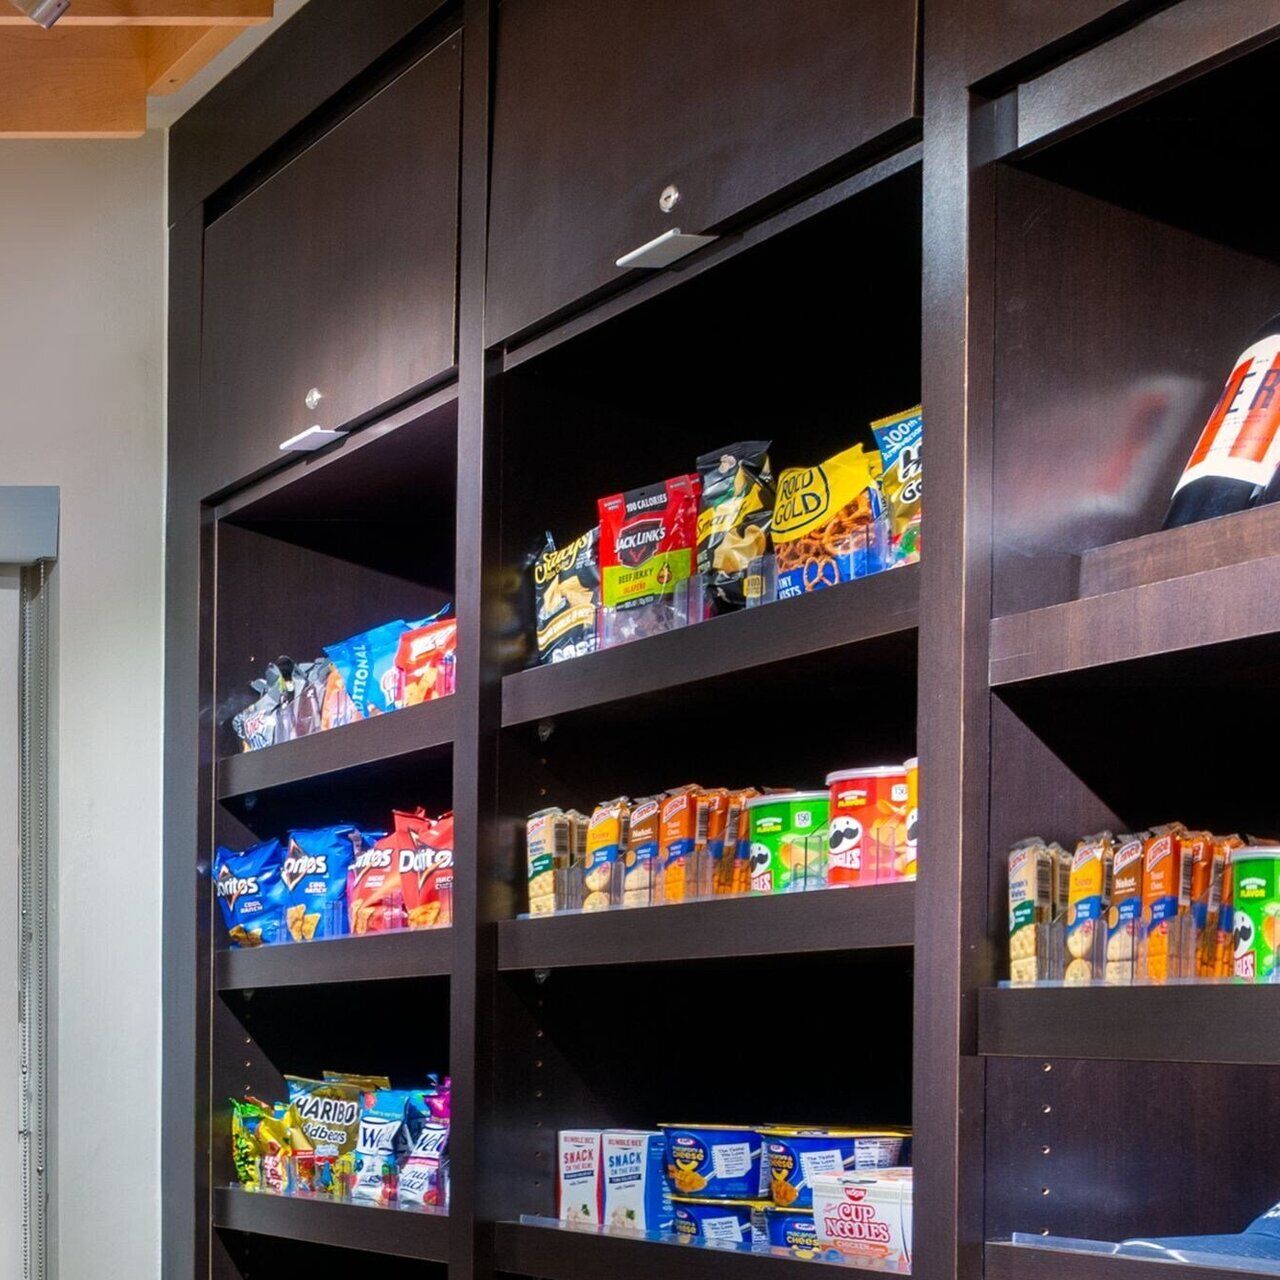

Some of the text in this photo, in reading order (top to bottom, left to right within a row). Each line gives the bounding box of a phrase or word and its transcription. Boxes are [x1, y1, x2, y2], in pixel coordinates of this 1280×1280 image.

[781, 469, 814, 500] ROLD
[638, 493, 667, 510] CALORIES
[775, 492, 822, 525] GOLD
[614, 527, 666, 553] JACK LINK'S
[618, 567, 654, 584] BEEF JERKY
[399, 849, 453, 873] Dorito
[216, 877, 259, 896] oritos
[564, 1148, 594, 1164] SNACK
[609, 1152, 642, 1167] SNACK
[838, 1203, 875, 1221] CUP
[825, 1218, 890, 1244] NOODLES
